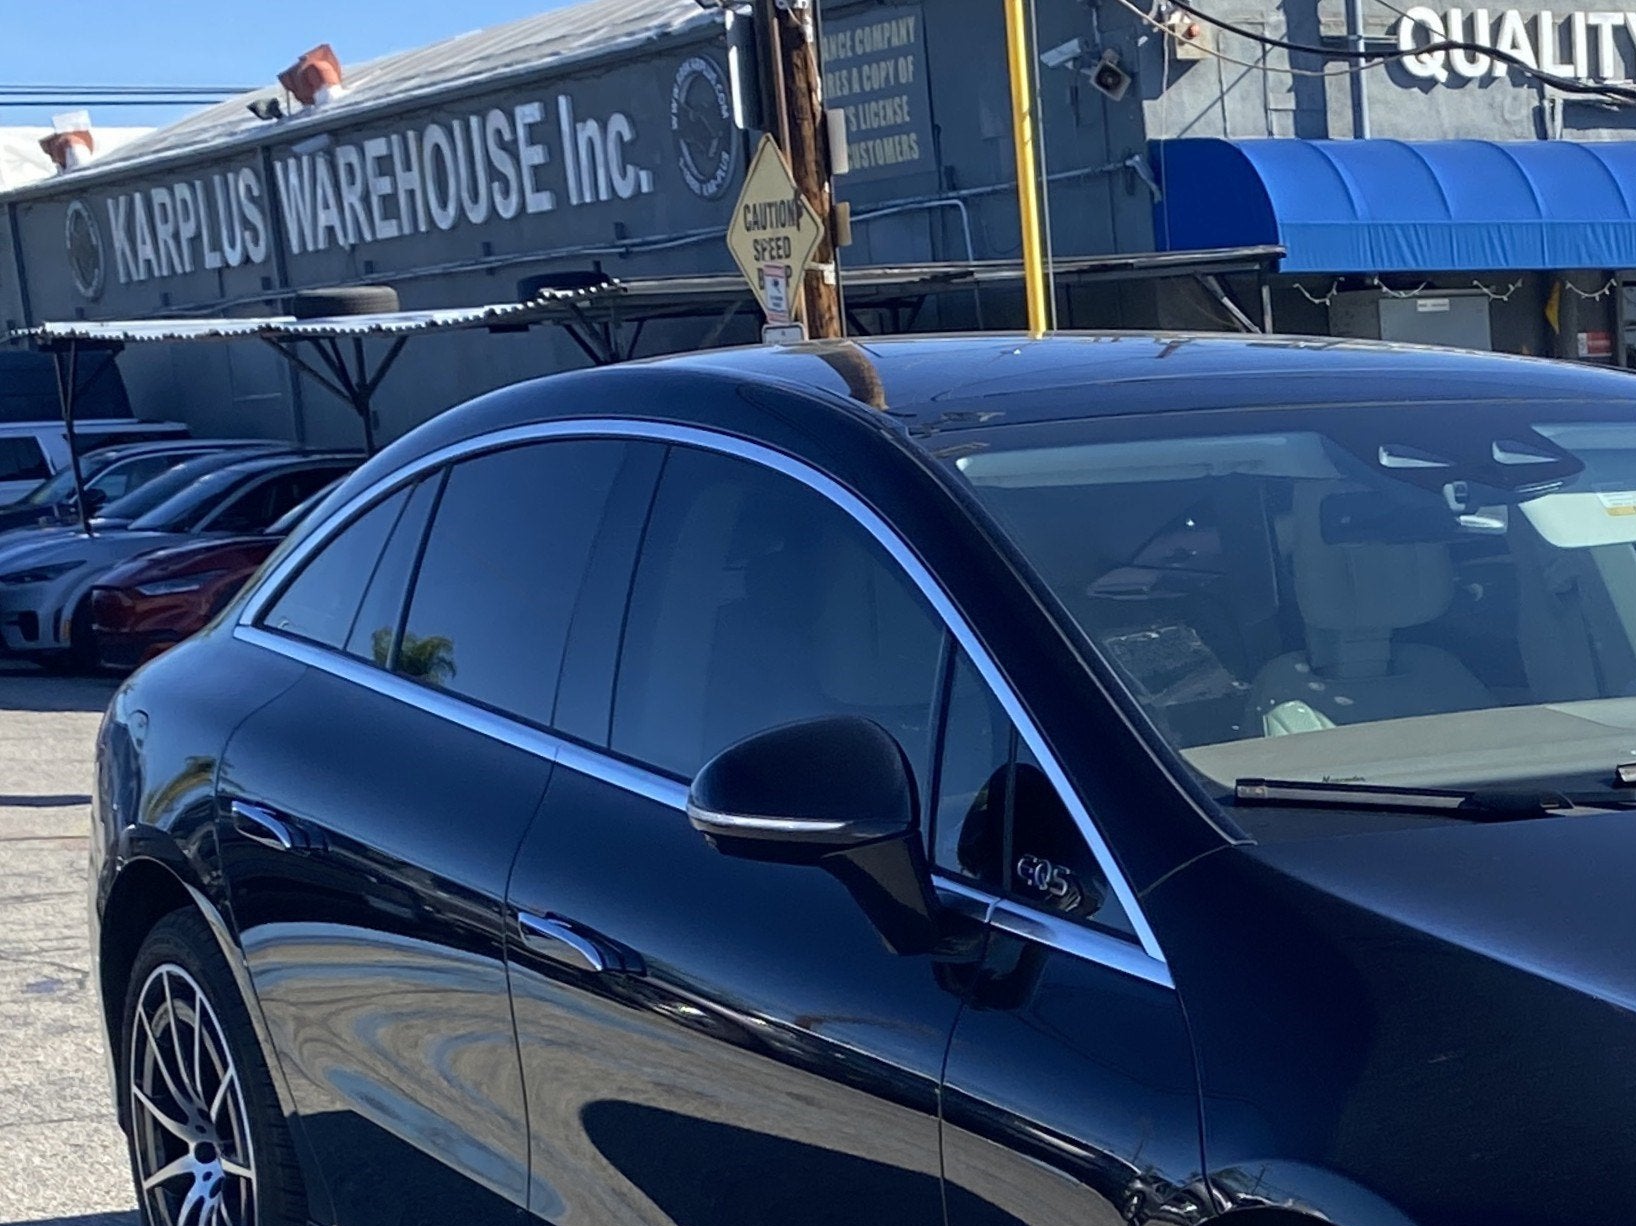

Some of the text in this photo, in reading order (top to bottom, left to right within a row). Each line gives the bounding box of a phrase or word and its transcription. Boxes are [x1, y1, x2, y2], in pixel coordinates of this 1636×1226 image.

[854, 16, 916, 56] COMPANY
[861, 59, 895, 92] COPY
[897, 55, 914, 84] OF
[858, 95, 910, 129] LICENSE
[106, 167, 267, 284] KARPLUS
[273, 101, 555, 255] WAREHOUSE
[557, 94, 654, 206] Inc.
[743, 199, 797, 233] CAUTION
[753, 236, 792, 261] SPEED
[1017, 853, 1071, 897] EQS
